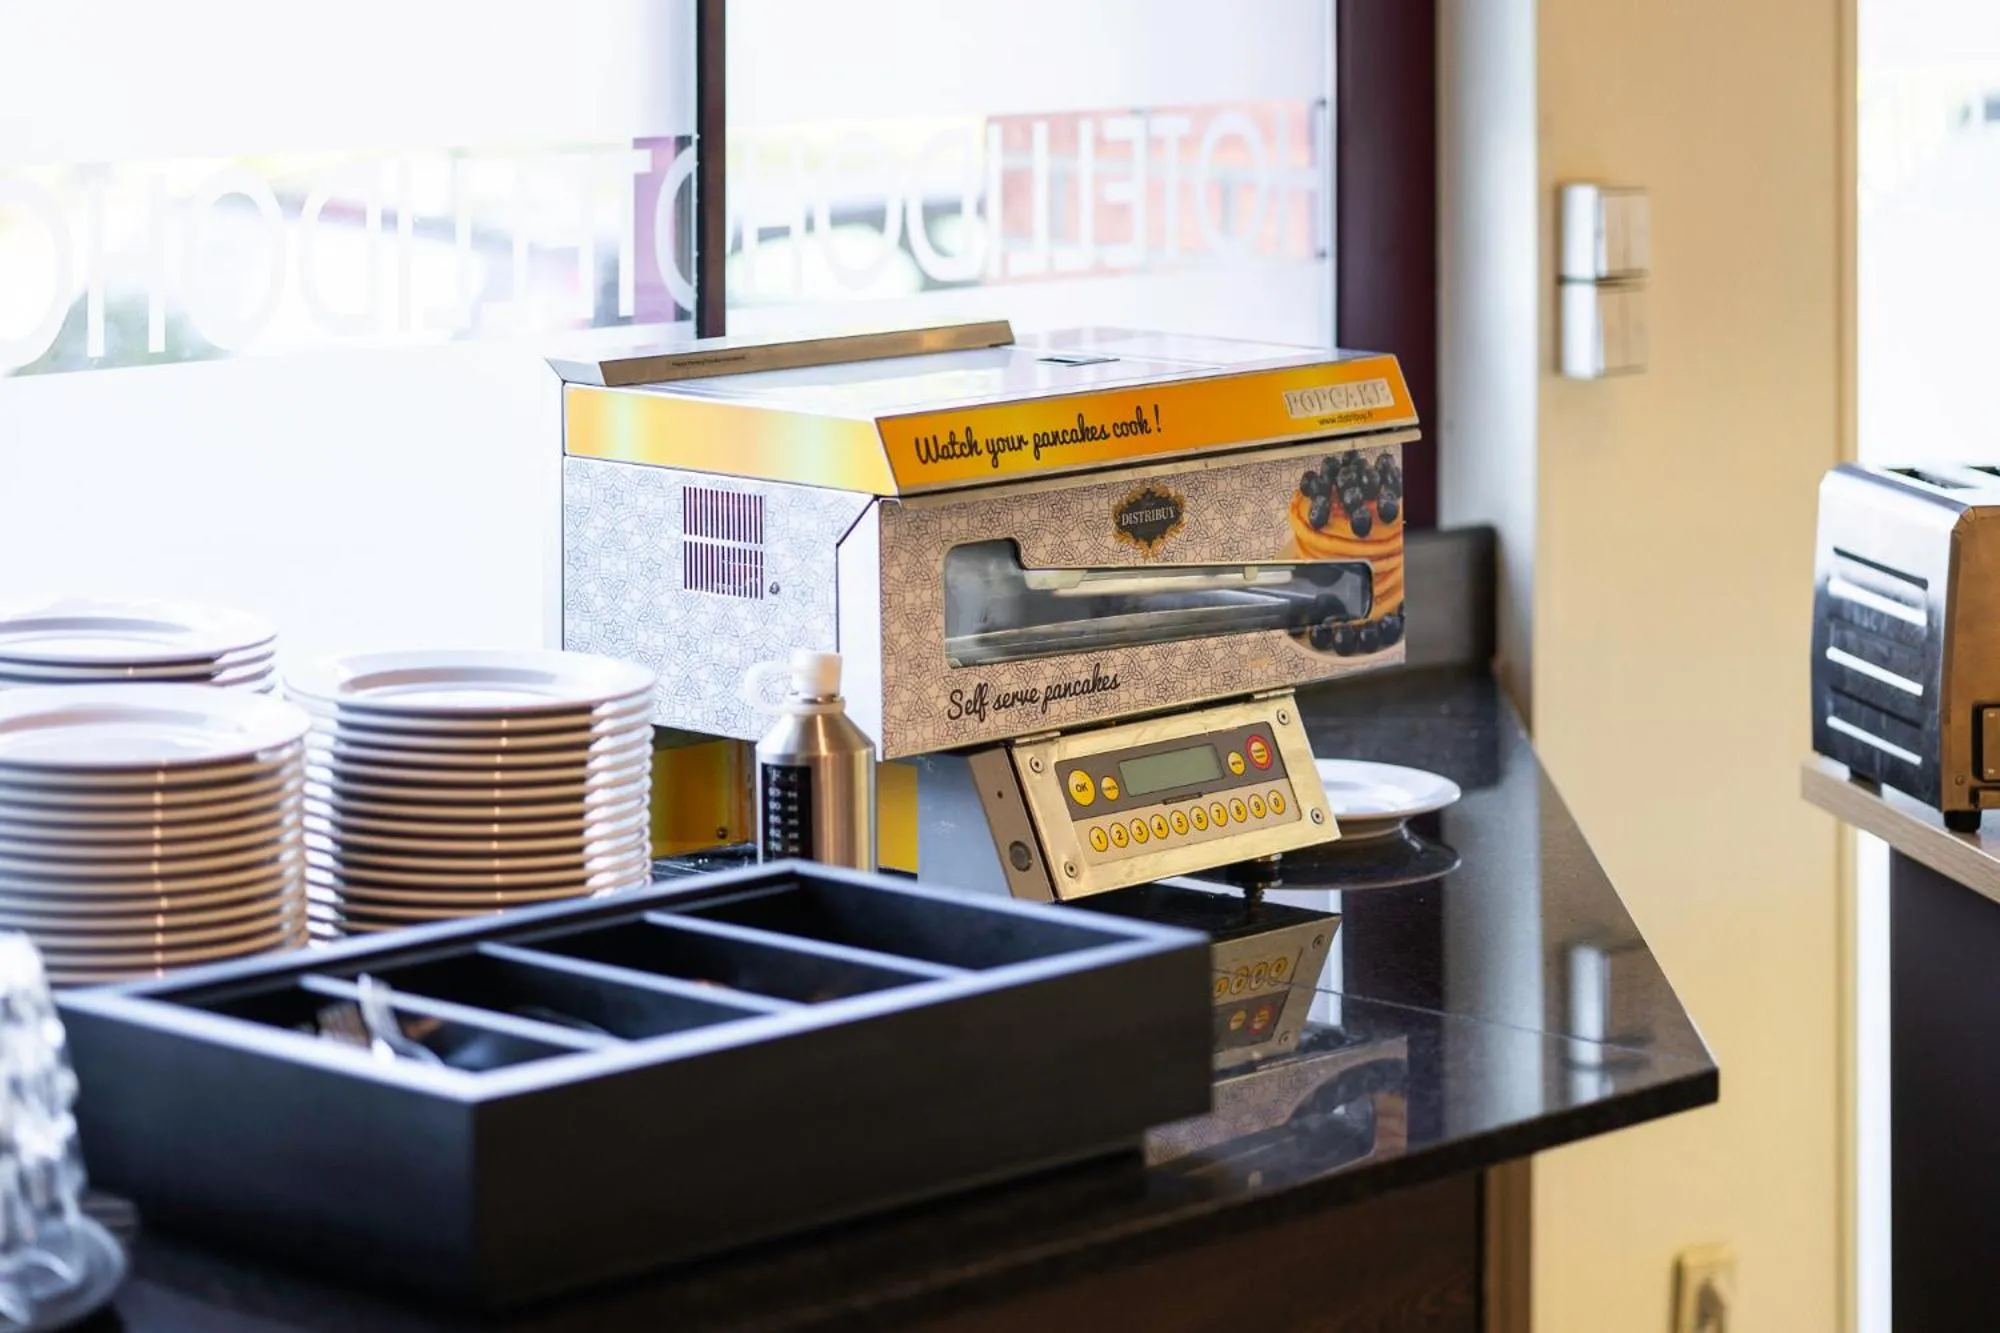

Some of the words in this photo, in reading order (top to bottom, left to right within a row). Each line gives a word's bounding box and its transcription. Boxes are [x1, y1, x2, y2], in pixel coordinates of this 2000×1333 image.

[1284, 382, 1391, 416] POPCAKE
[914, 426, 982, 464] Watch
[985, 434, 1028, 468] your
[1033, 413, 1110, 460] pancakes
[1112, 405, 1152, 438] cook
[1121, 506, 1175, 526] DISTRIBUY
[947, 683, 989, 722] Self
[992, 688, 1040, 711] serve
[1041, 663, 1121, 714] pancakes
[1075, 782, 1089, 793] OK
